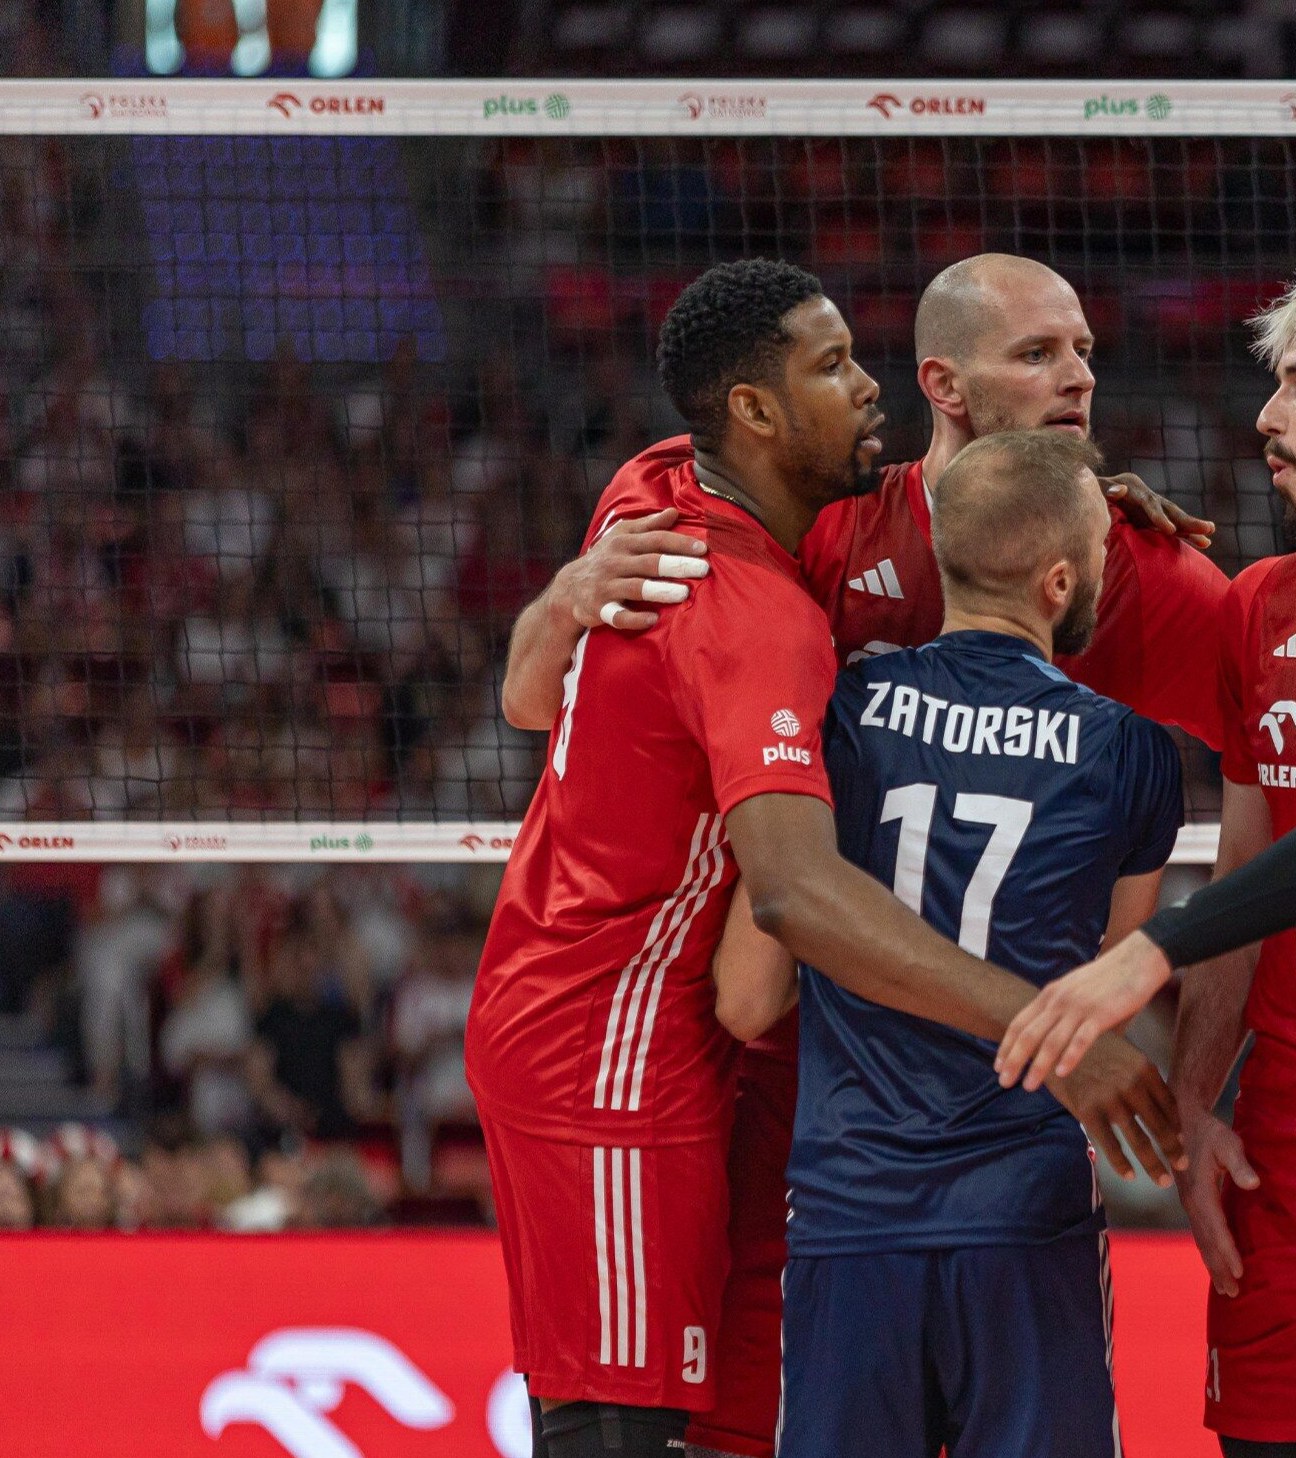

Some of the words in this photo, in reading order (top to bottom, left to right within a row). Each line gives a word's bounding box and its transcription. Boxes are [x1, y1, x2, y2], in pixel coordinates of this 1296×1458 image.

[309, 97, 384, 114] ORLEN
[483, 95, 538, 119] plus
[910, 97, 985, 115] ORLEN
[1083, 96, 1138, 120] plus
[860, 682, 1080, 764] ZATORSKI
[763, 742, 811, 766] plus
[18, 837, 74, 849] ORLEN
[310, 835, 350, 852] plus
[880, 783, 1034, 960] 17
[682, 1326, 706, 1384] 9
